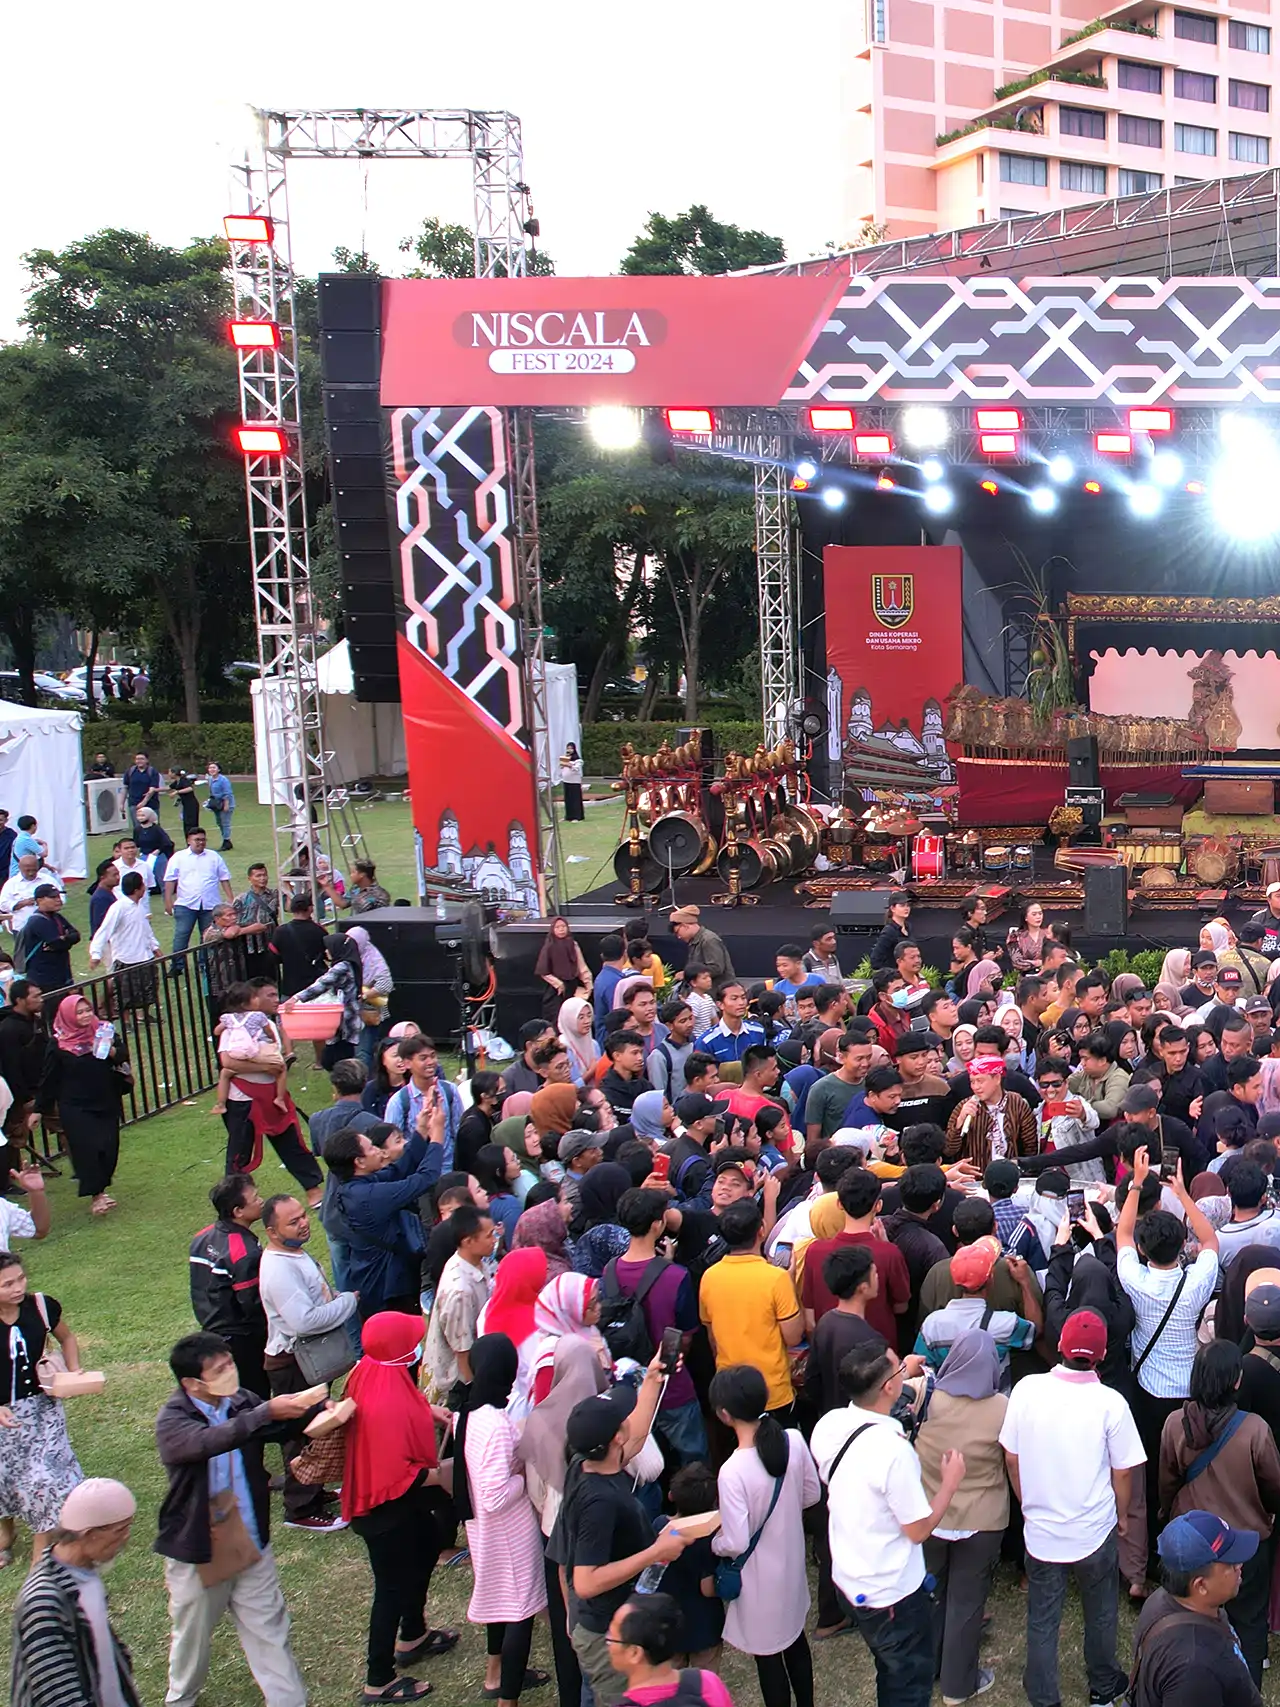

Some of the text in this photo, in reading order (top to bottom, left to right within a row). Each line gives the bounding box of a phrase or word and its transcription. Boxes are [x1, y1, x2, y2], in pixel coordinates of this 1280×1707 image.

[471, 312, 651, 347] NISCALA
[512, 353, 614, 370] FEST 2024
